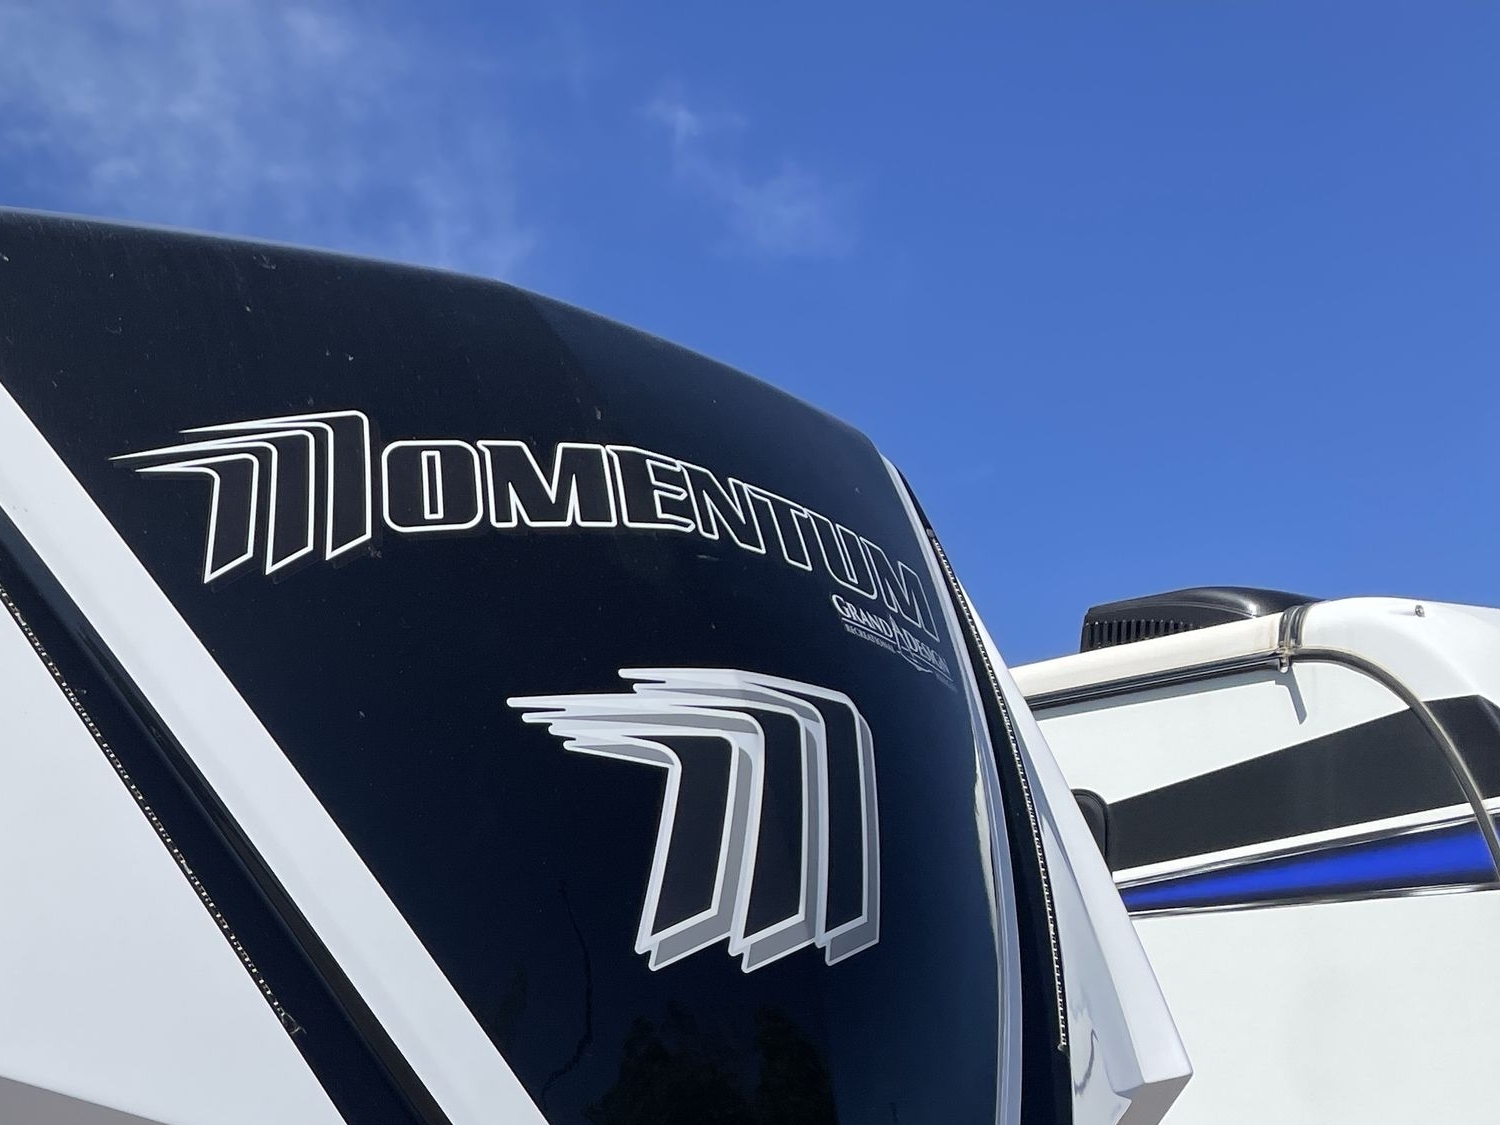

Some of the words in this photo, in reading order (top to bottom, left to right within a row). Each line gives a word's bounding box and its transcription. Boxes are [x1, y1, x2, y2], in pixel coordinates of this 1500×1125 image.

[110, 409, 940, 643] MOMENTUM
[831, 593, 894, 639] GRAND
[900, 627, 951, 675] DESIGN
